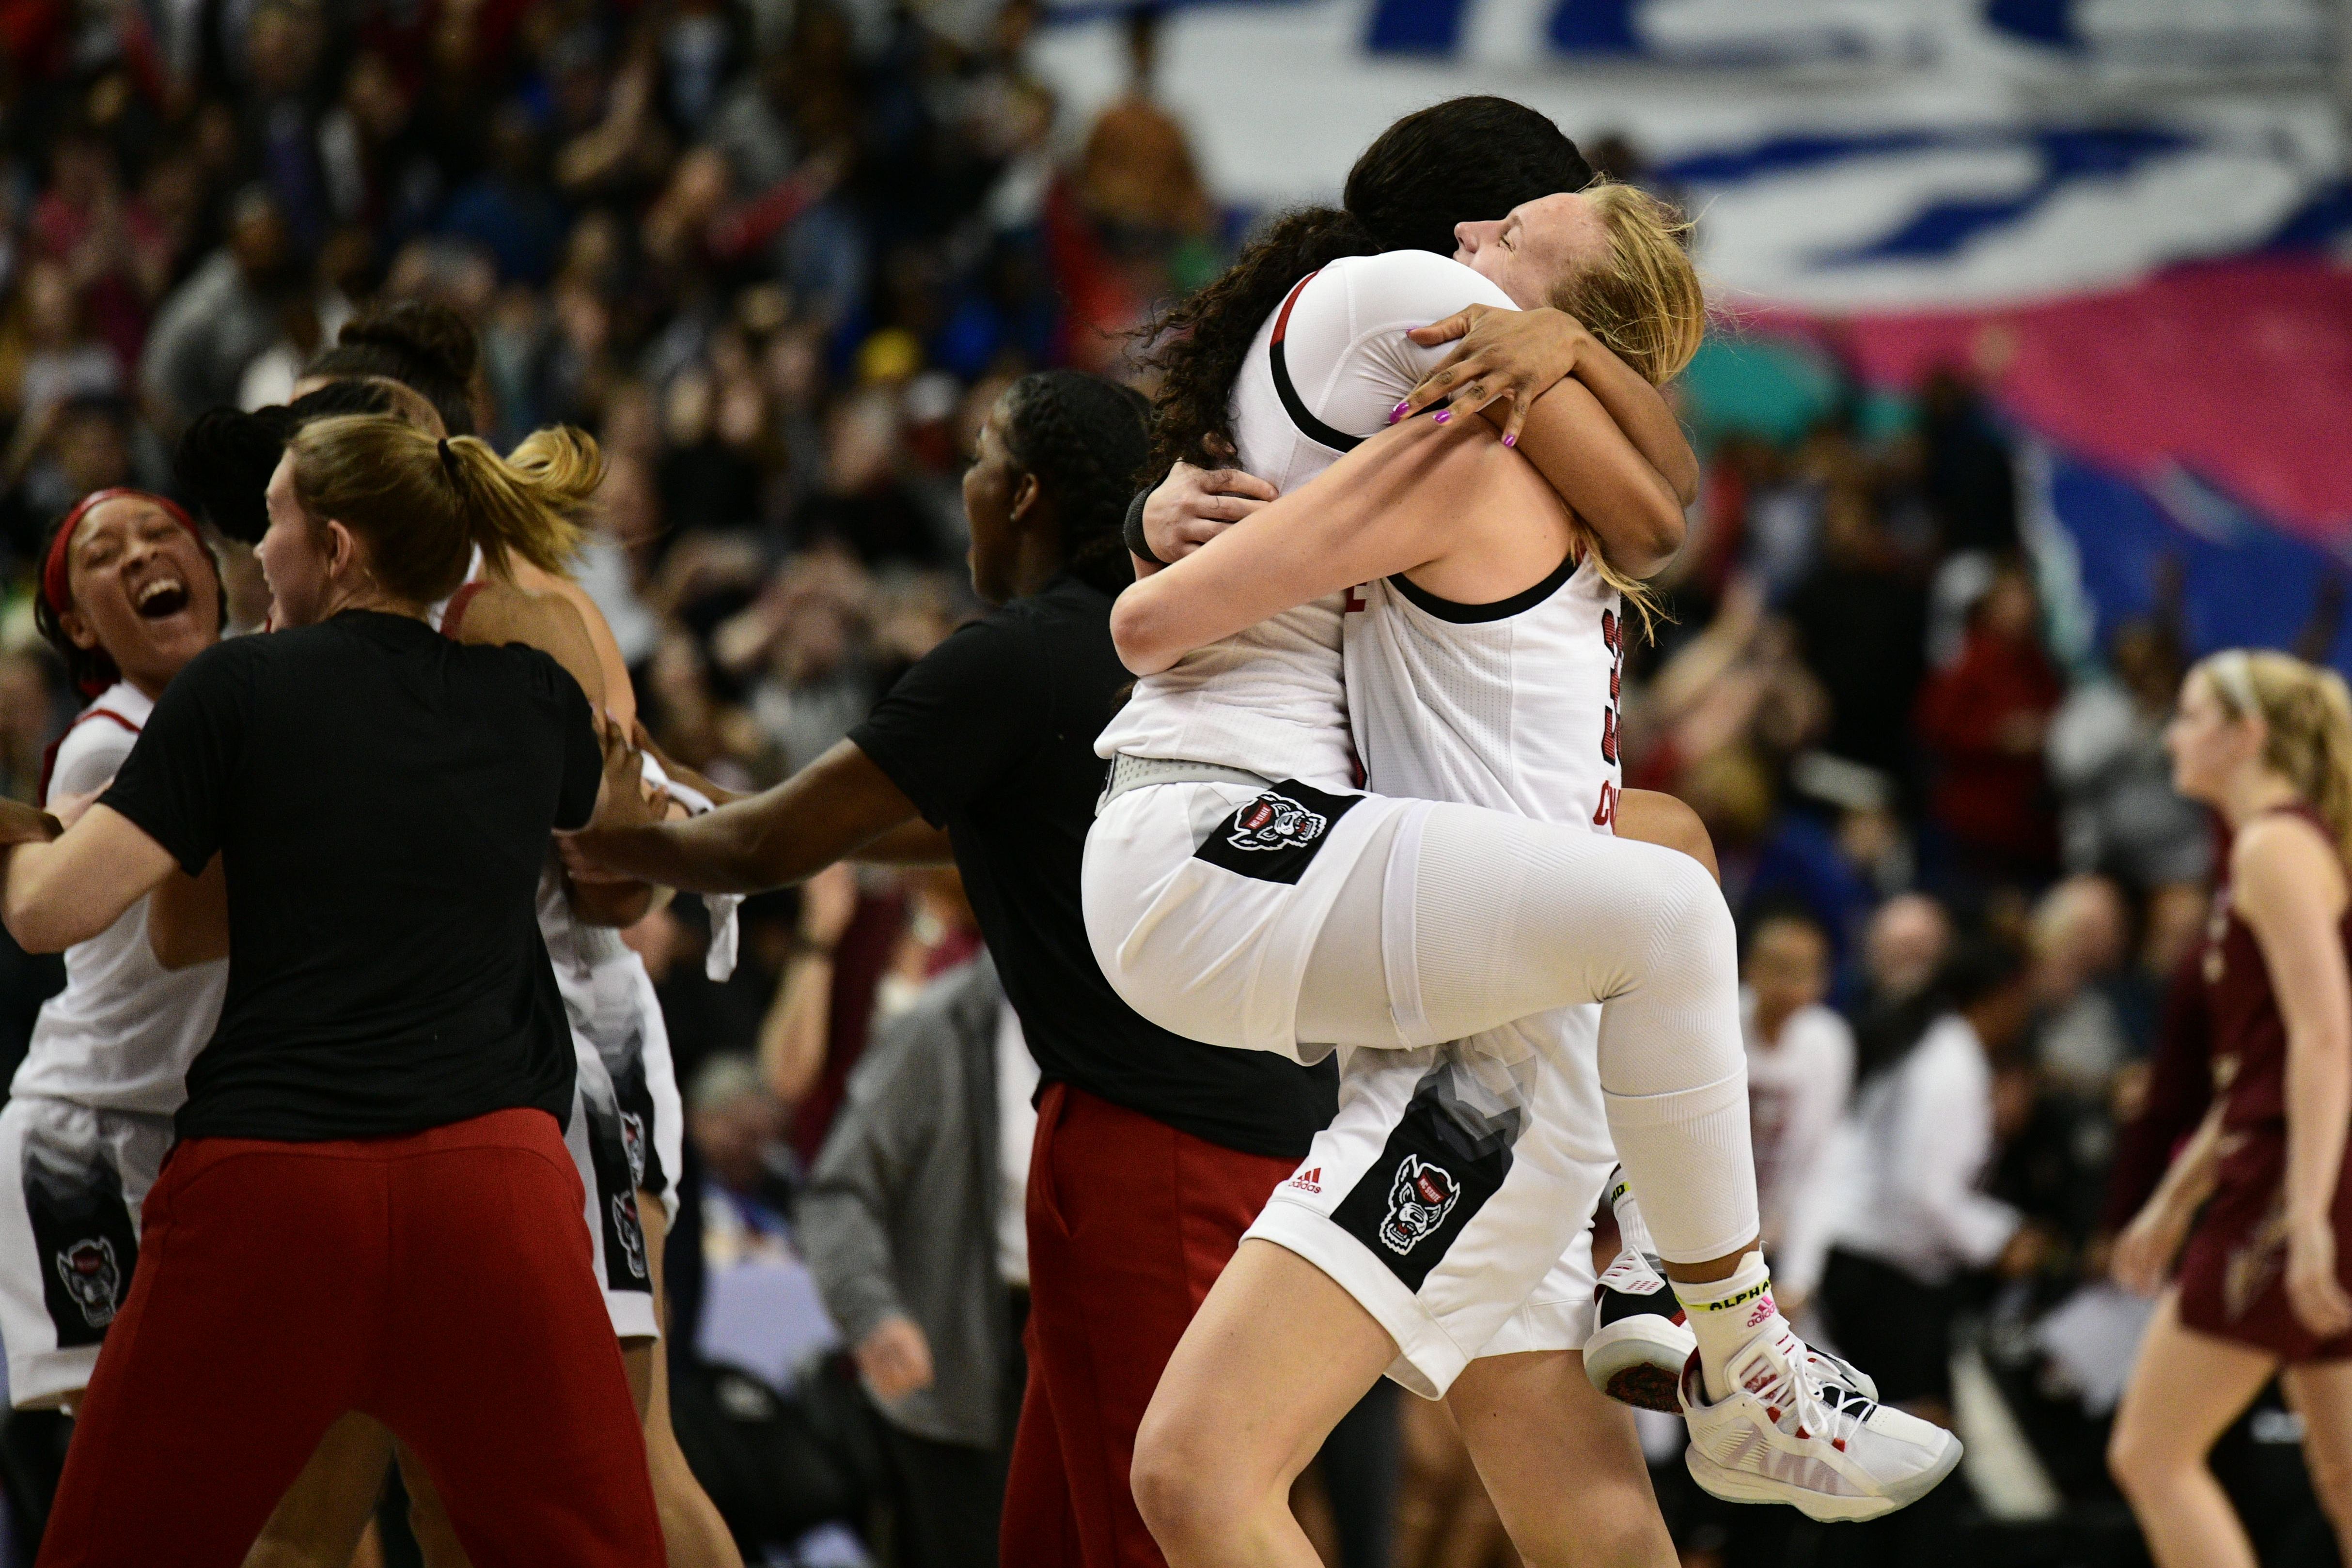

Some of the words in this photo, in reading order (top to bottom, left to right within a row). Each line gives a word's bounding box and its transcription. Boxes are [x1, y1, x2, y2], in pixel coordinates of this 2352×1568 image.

[1255, 806, 1270, 822] STATE
[1425, 1186, 1441, 1203] STATE
[1710, 1281, 1770, 1311] ALPHA
[1747, 1304, 1775, 1327] adida
